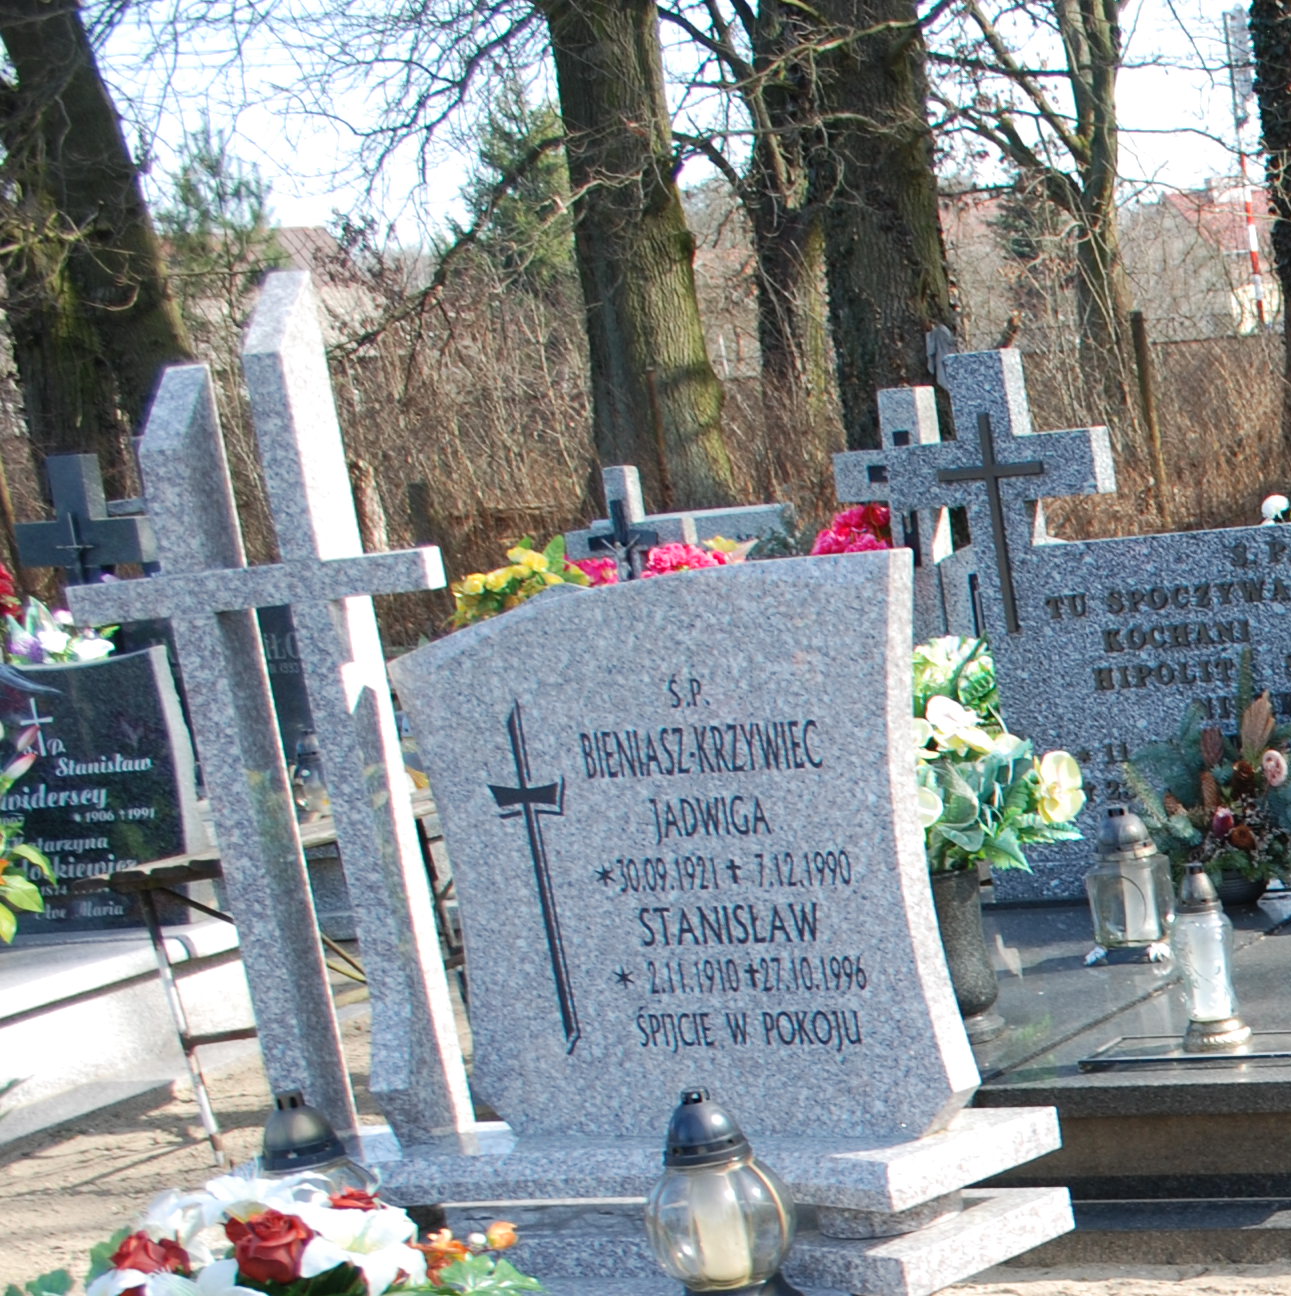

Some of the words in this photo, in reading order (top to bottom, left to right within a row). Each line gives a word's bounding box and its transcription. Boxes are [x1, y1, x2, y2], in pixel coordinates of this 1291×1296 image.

[1045, 592, 1087, 620] TU
[1102, 618, 1252, 653] KOCHANI
[1092, 656, 1235, 691] HIPOLIT
[55, 753, 153, 777] Stanisław
[579, 720, 823, 780] BIENIASZ-KRZYWIEC
[649, 795, 772, 846] JADWIGA
[615, 855, 720, 893] 30.09.1921
[754, 850, 853, 889] 7.12.1990
[638, 903, 818, 946] STANISŁAW
[648, 958, 740, 994] 2.11.1910
[760, 955, 868, 993] 27.10.1996
[726, 1012, 750, 1046] W
[762, 1010, 863, 1052] POKOJU
